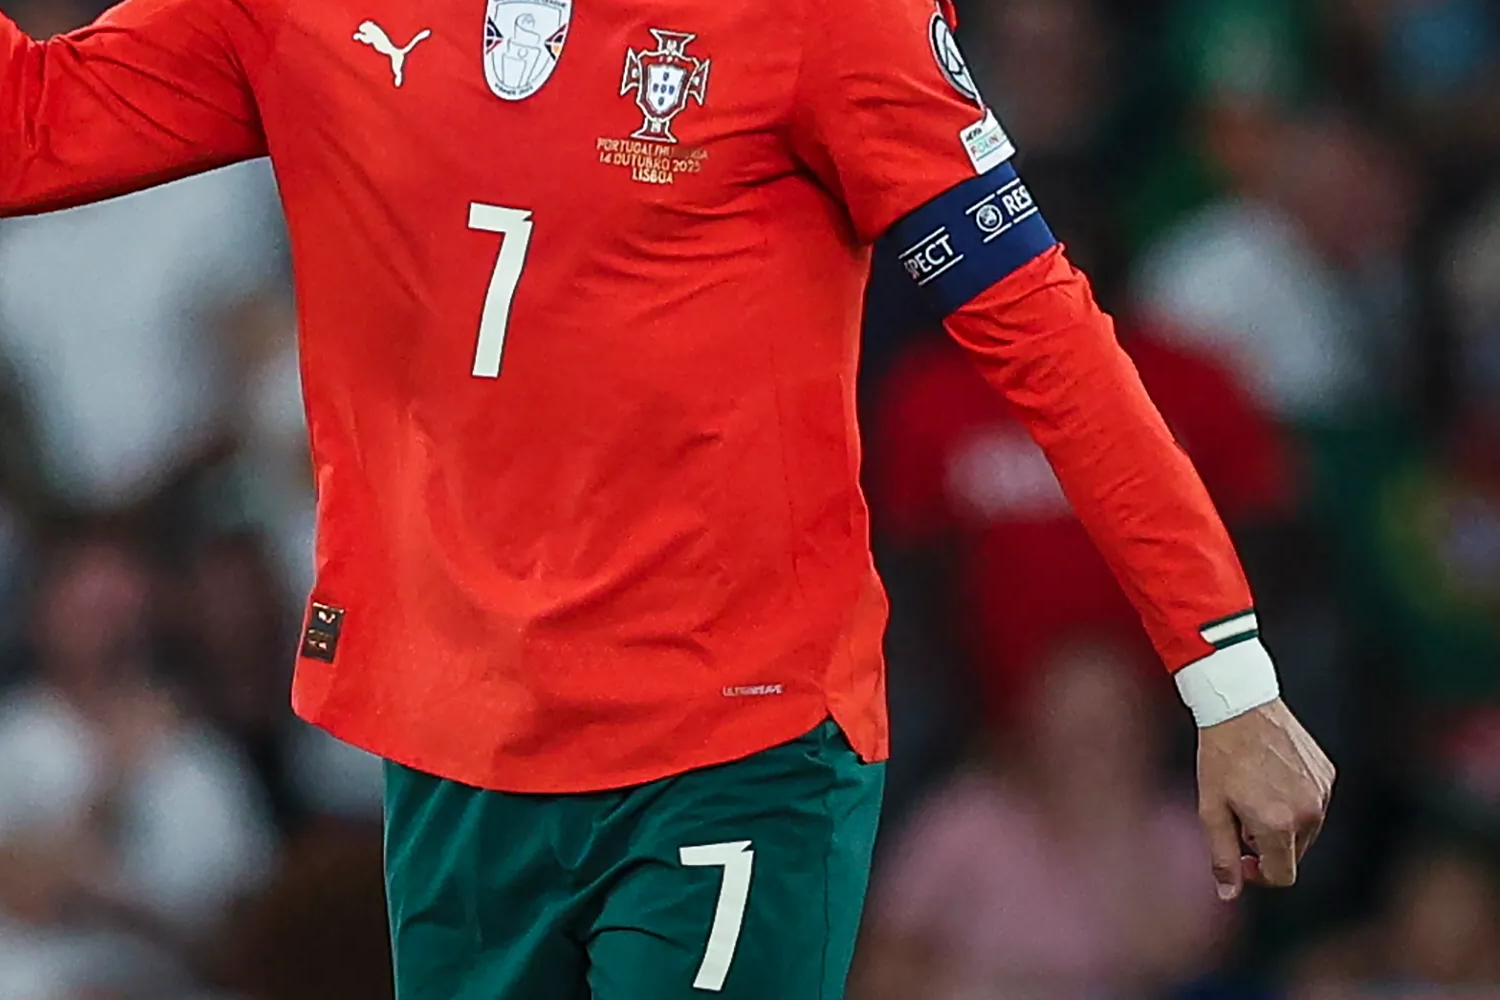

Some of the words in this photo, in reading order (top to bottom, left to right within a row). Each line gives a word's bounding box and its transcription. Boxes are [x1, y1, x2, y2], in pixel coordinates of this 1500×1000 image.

[613, 153, 670, 171] OUTUBRO
[632, 167, 674, 184] LISBOA
[467, 202, 534, 378] 7
[679, 840, 755, 991] 7
